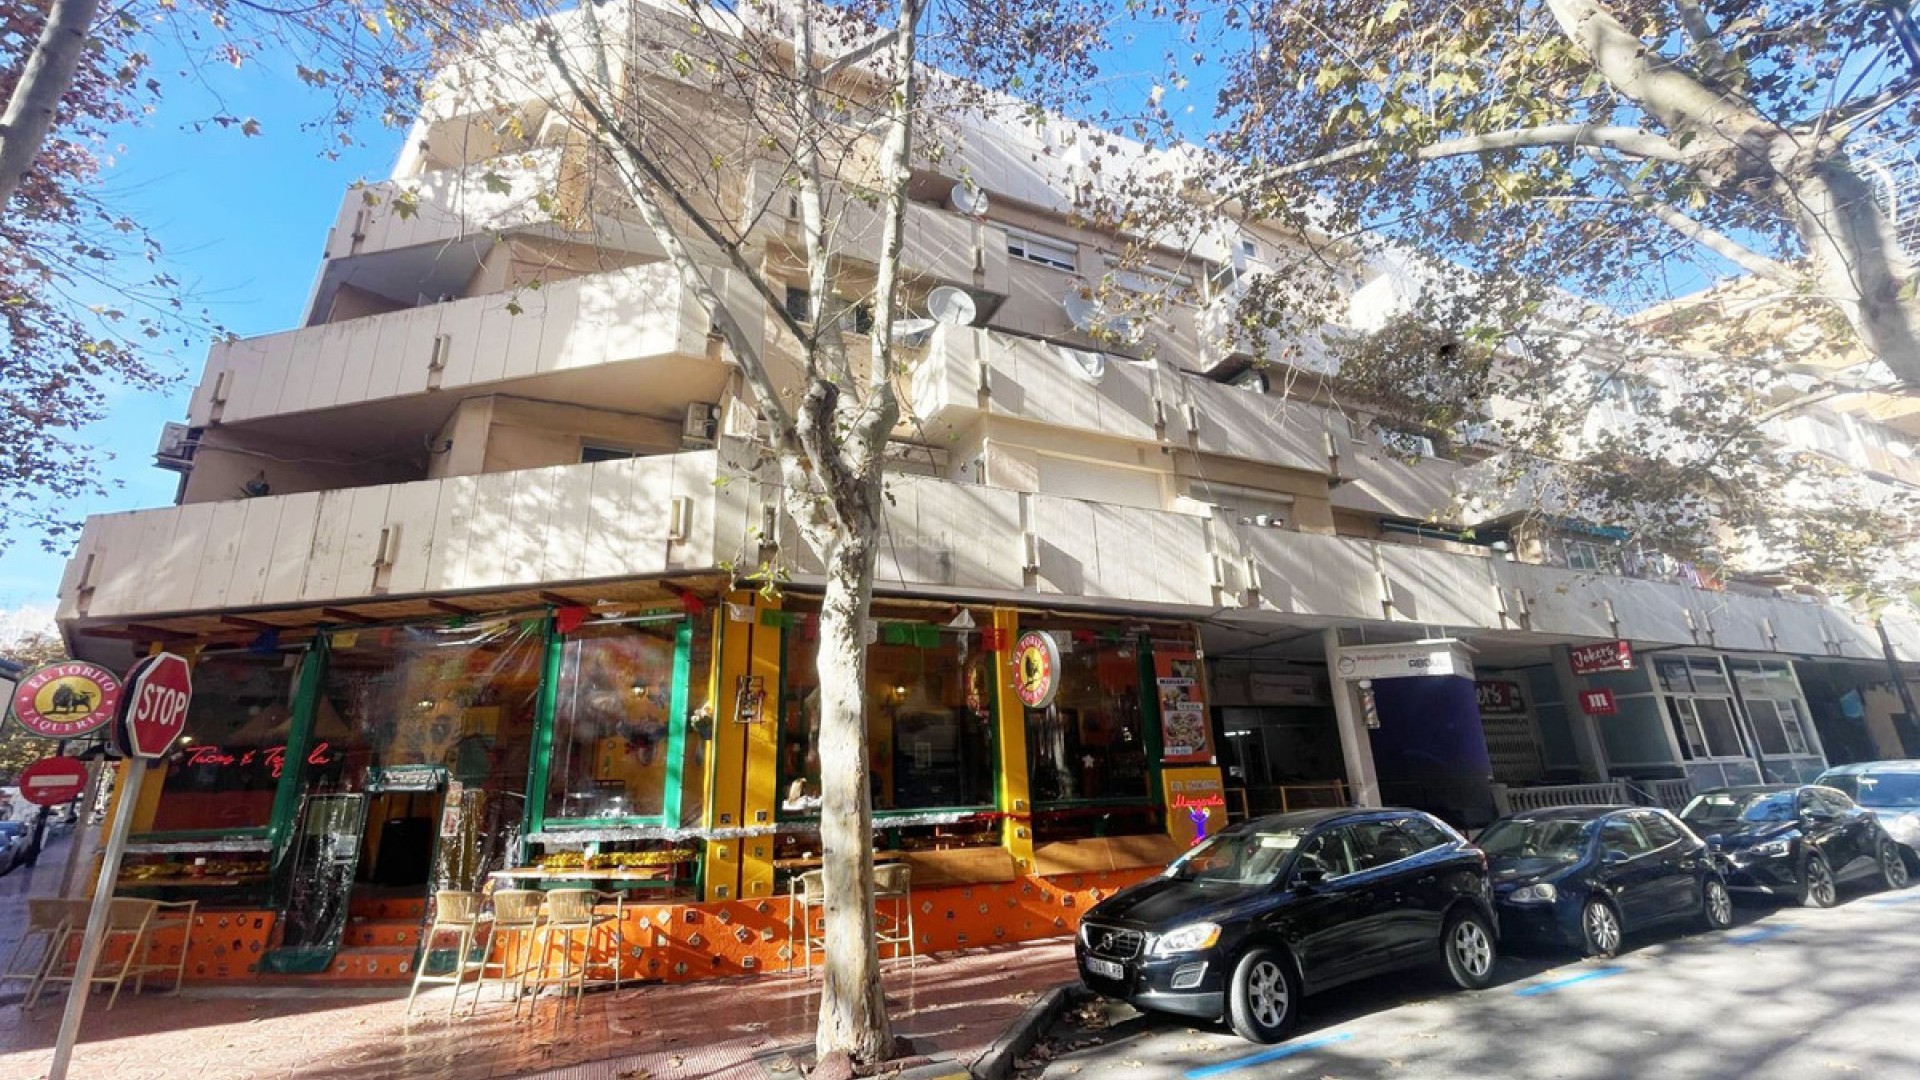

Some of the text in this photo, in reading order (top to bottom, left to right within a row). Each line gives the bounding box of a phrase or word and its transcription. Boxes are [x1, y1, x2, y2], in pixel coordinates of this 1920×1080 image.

[28, 665, 116, 691] EL TORITO
[138, 683, 187, 726] STOP
[24, 711, 105, 732] TAQUERIA
[185, 745, 235, 767] Tacos
[263, 742, 331, 778] Teqla
